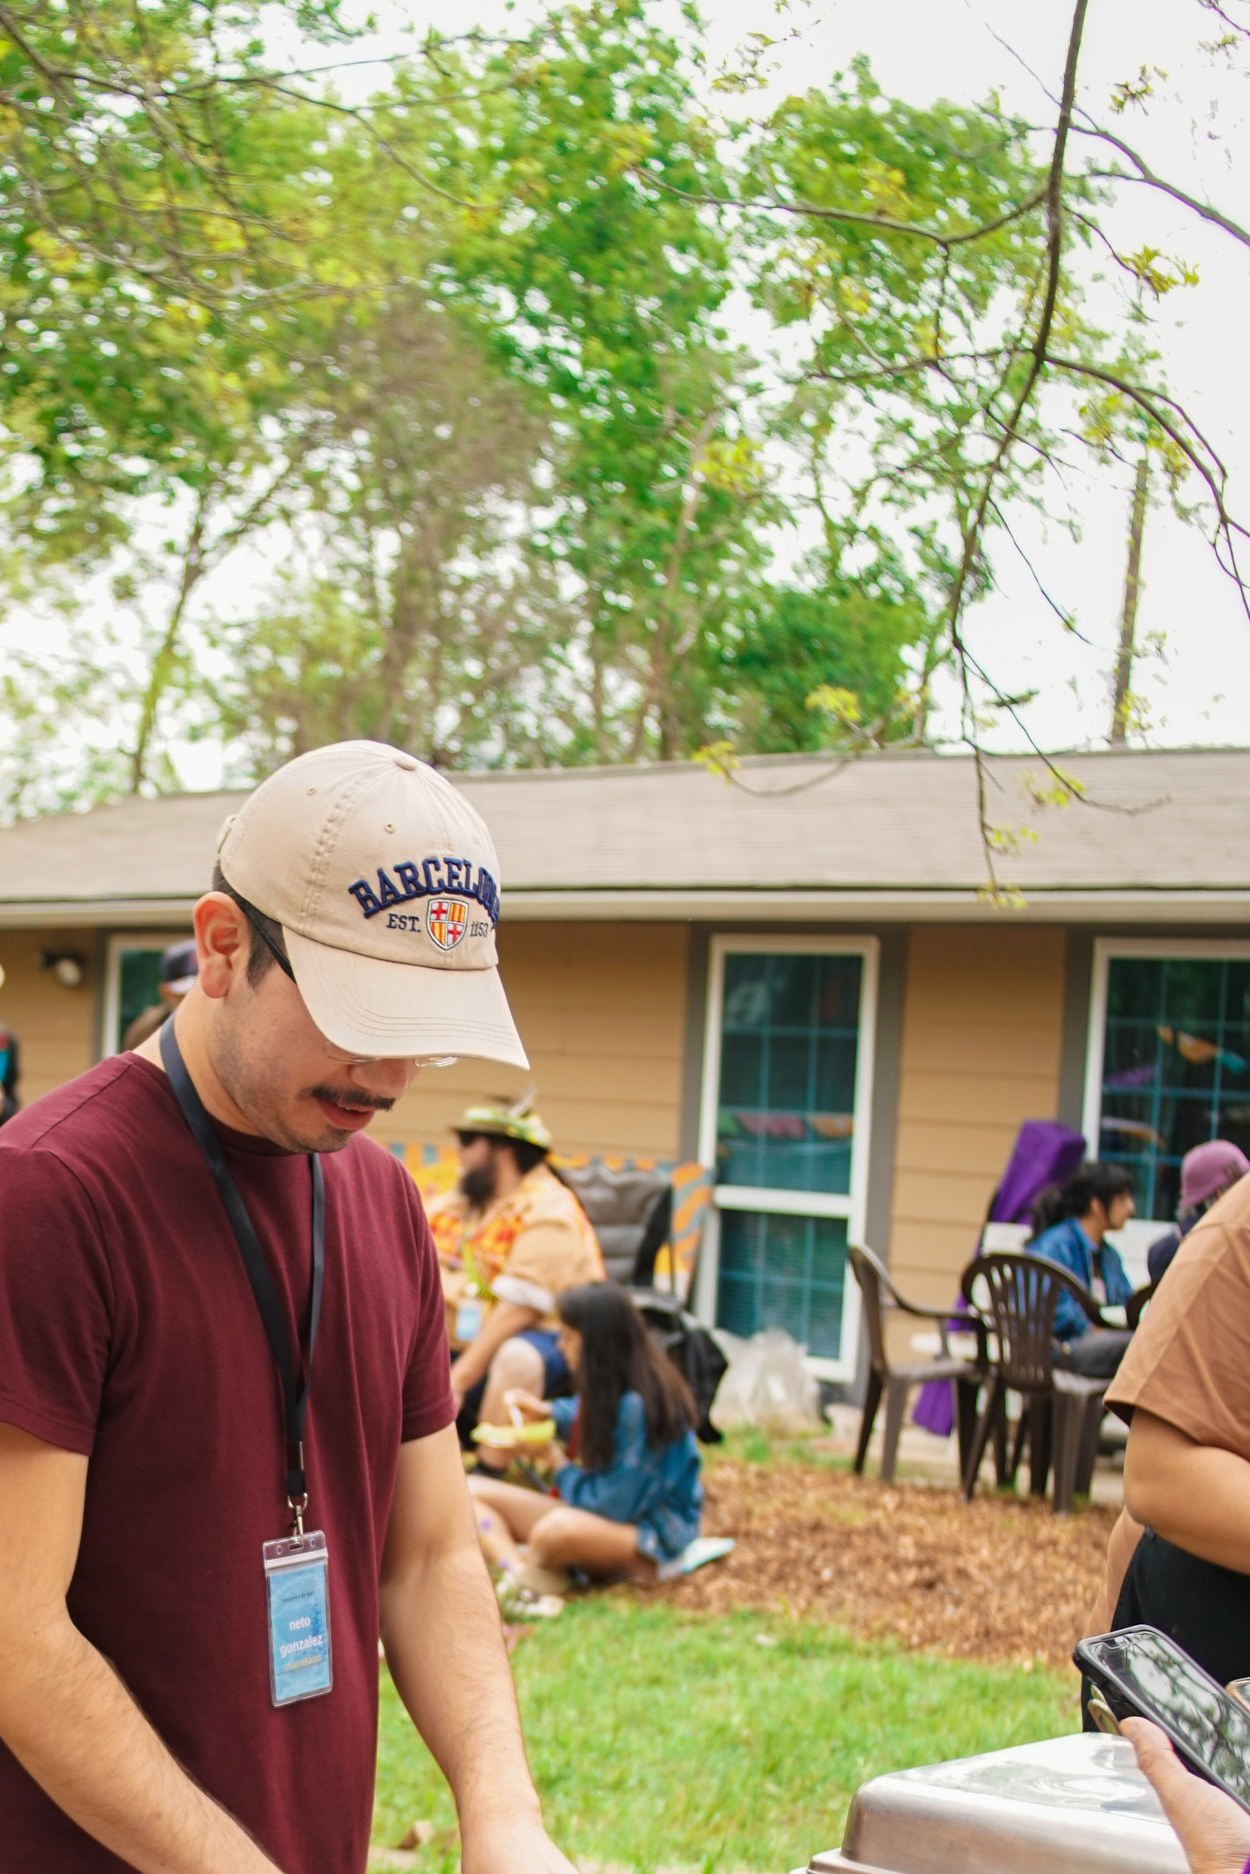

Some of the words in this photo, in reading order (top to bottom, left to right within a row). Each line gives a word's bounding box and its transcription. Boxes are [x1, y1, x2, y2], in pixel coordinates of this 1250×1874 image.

[386, 913, 422, 933] EST.
[289, 1616, 311, 1631] neto
[279, 1634, 323, 1658] gonzalez
